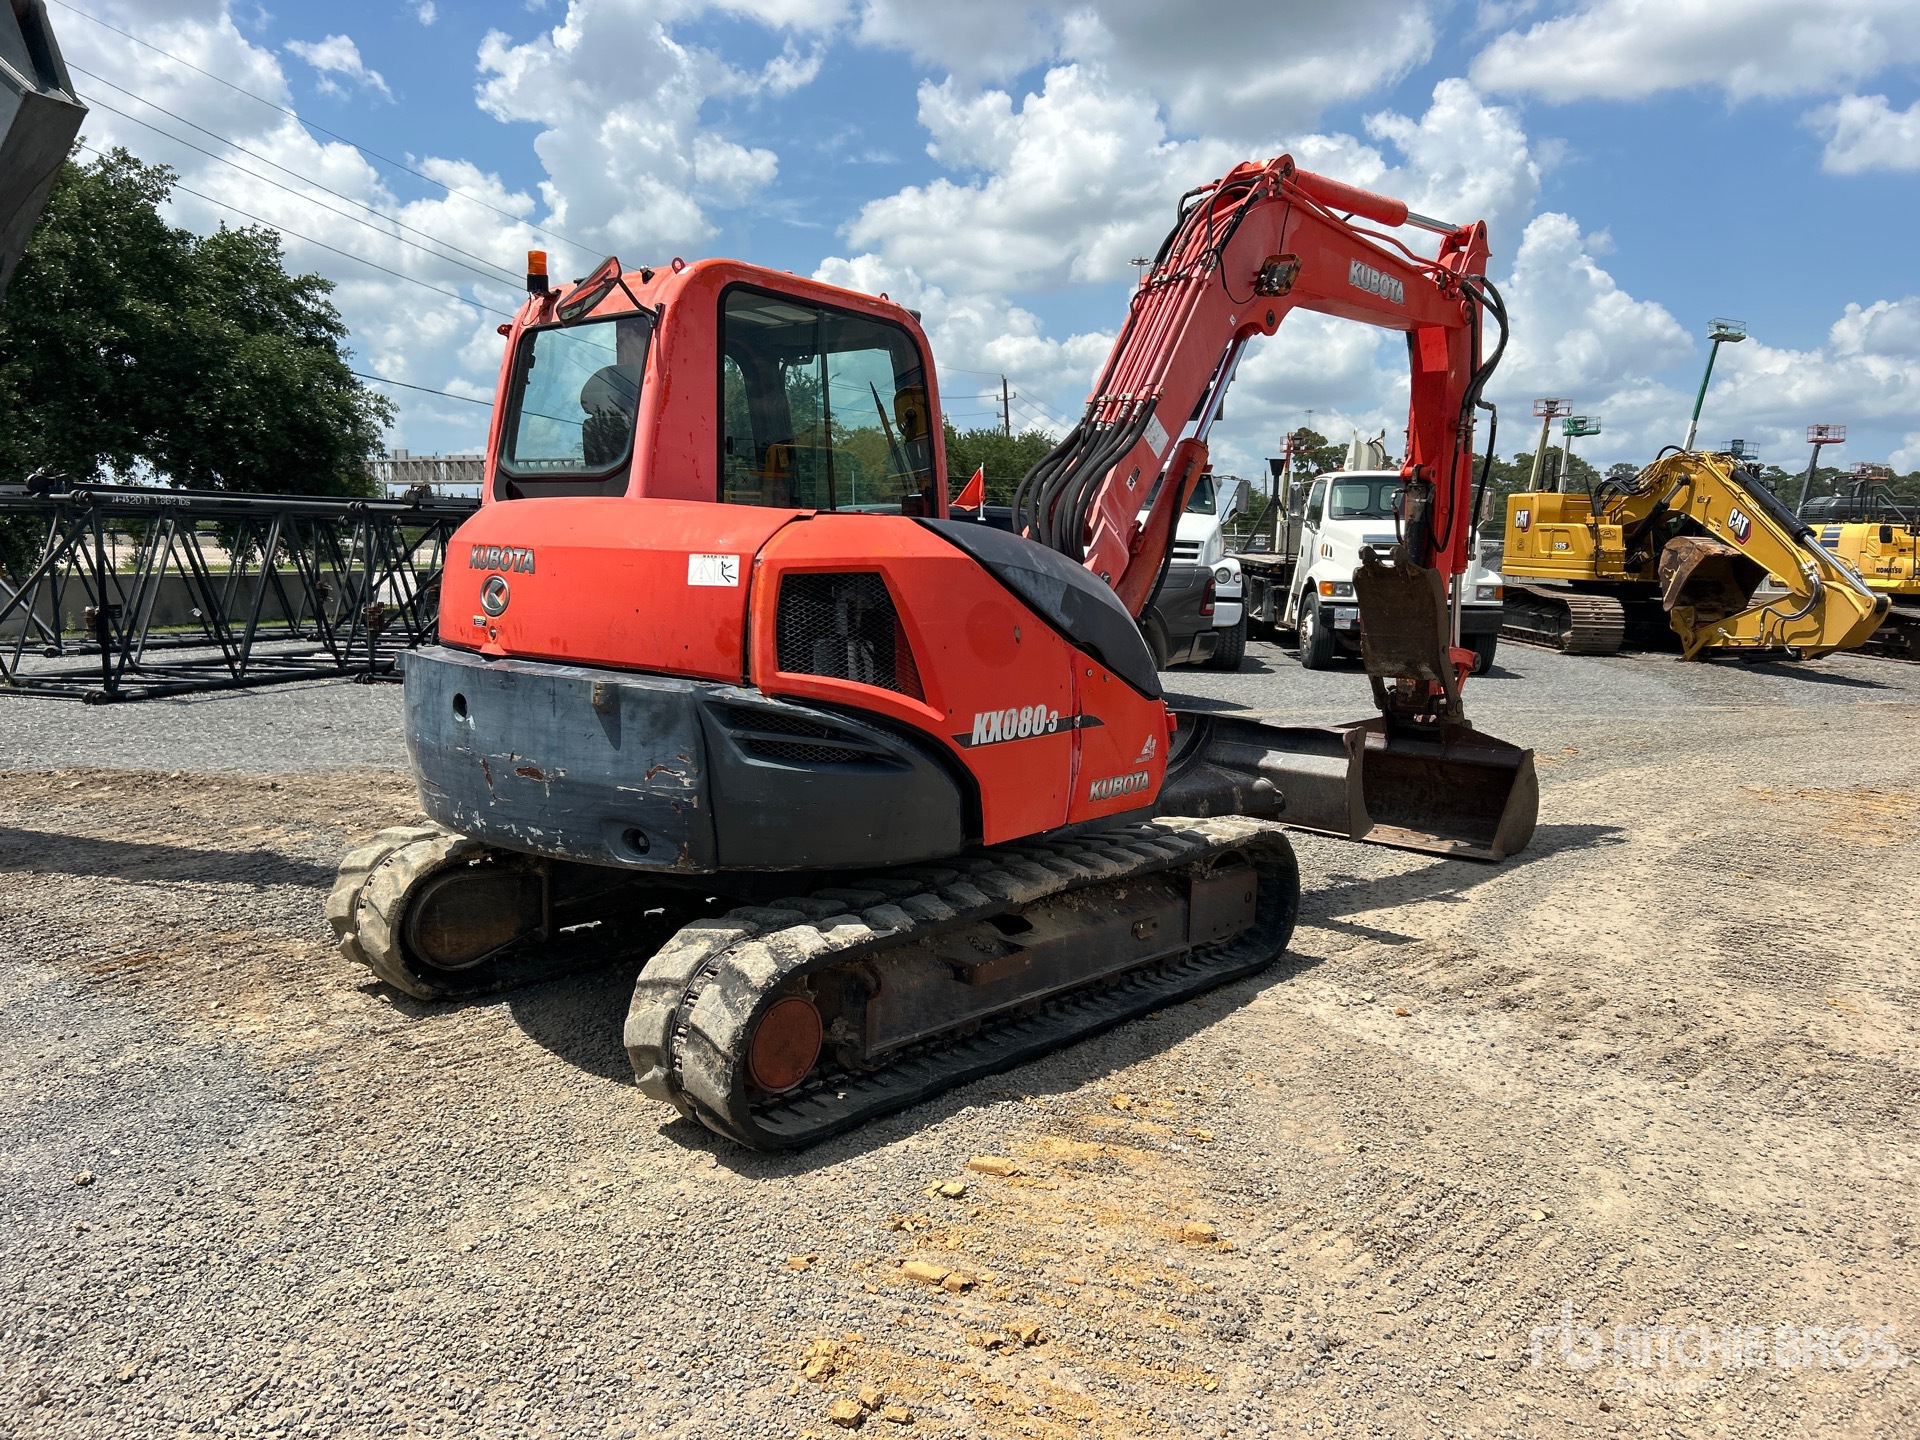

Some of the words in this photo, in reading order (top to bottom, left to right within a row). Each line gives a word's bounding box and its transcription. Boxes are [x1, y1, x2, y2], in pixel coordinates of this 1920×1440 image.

[1349, 258, 1405, 305] KUBOTA
[1515, 510, 1529, 528] CAT
[1727, 507, 1749, 537] CAT
[469, 544, 536, 575] KUBOTA
[1554, 542, 1567, 550] 335
[1089, 770, 1150, 802] KUBOTA
